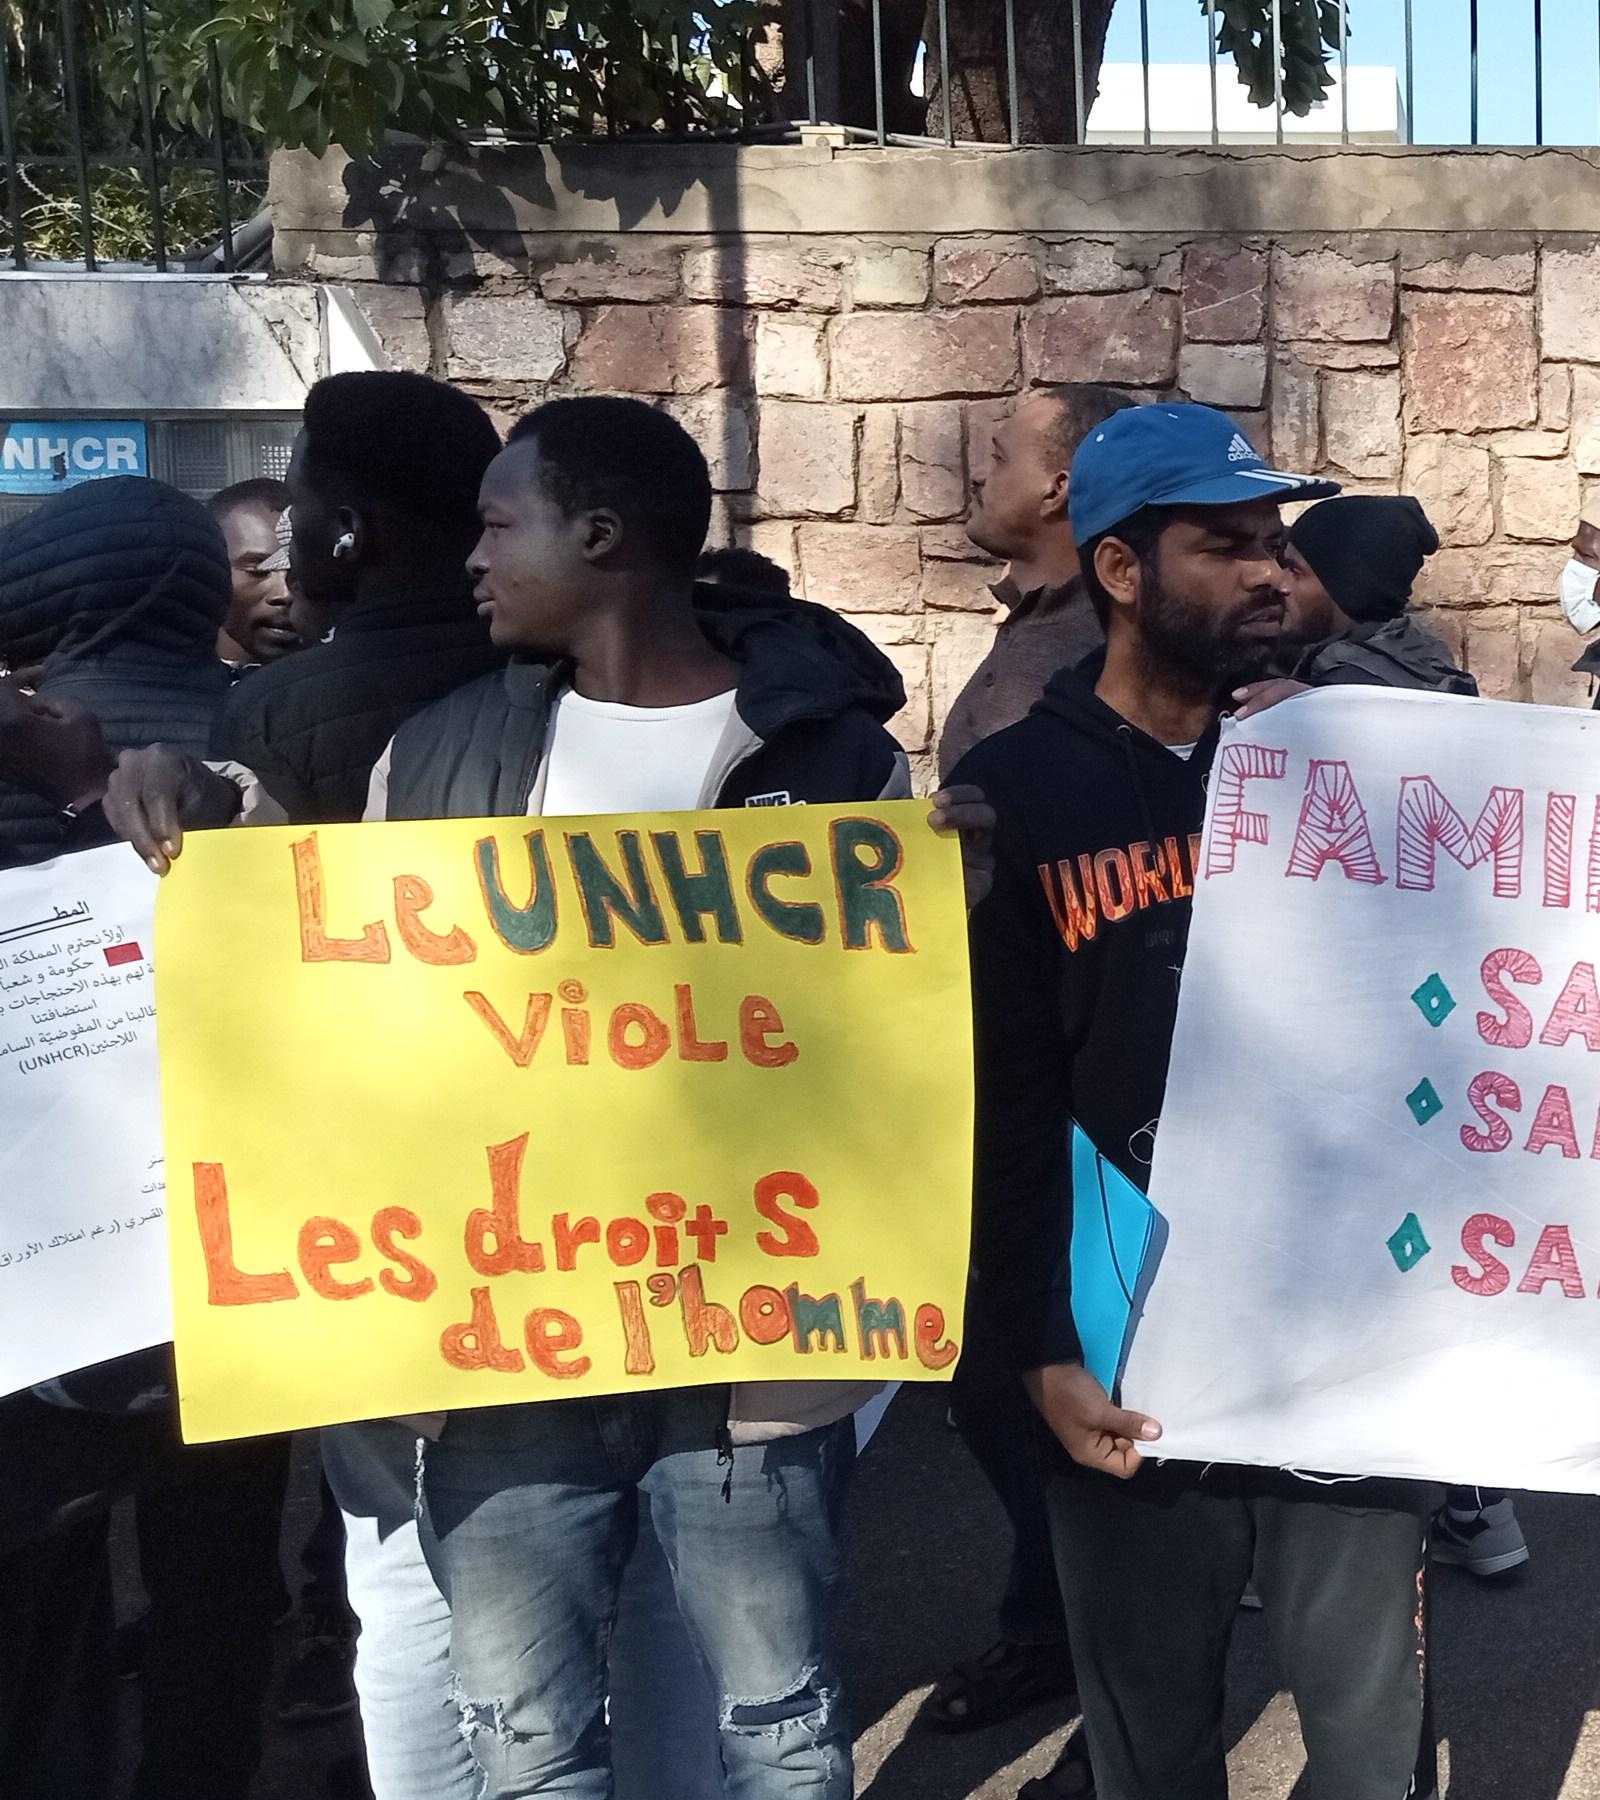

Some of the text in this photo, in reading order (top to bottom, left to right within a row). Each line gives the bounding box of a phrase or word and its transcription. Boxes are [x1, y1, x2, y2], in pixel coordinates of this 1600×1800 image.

[2, 436, 139, 471] NHCR
[290, 817, 917, 964] Le UNHCR
[125, 1004, 157, 1022] طالبنا
[192, 1161, 437, 1306] Les
[440, 1286, 592, 1379] de
